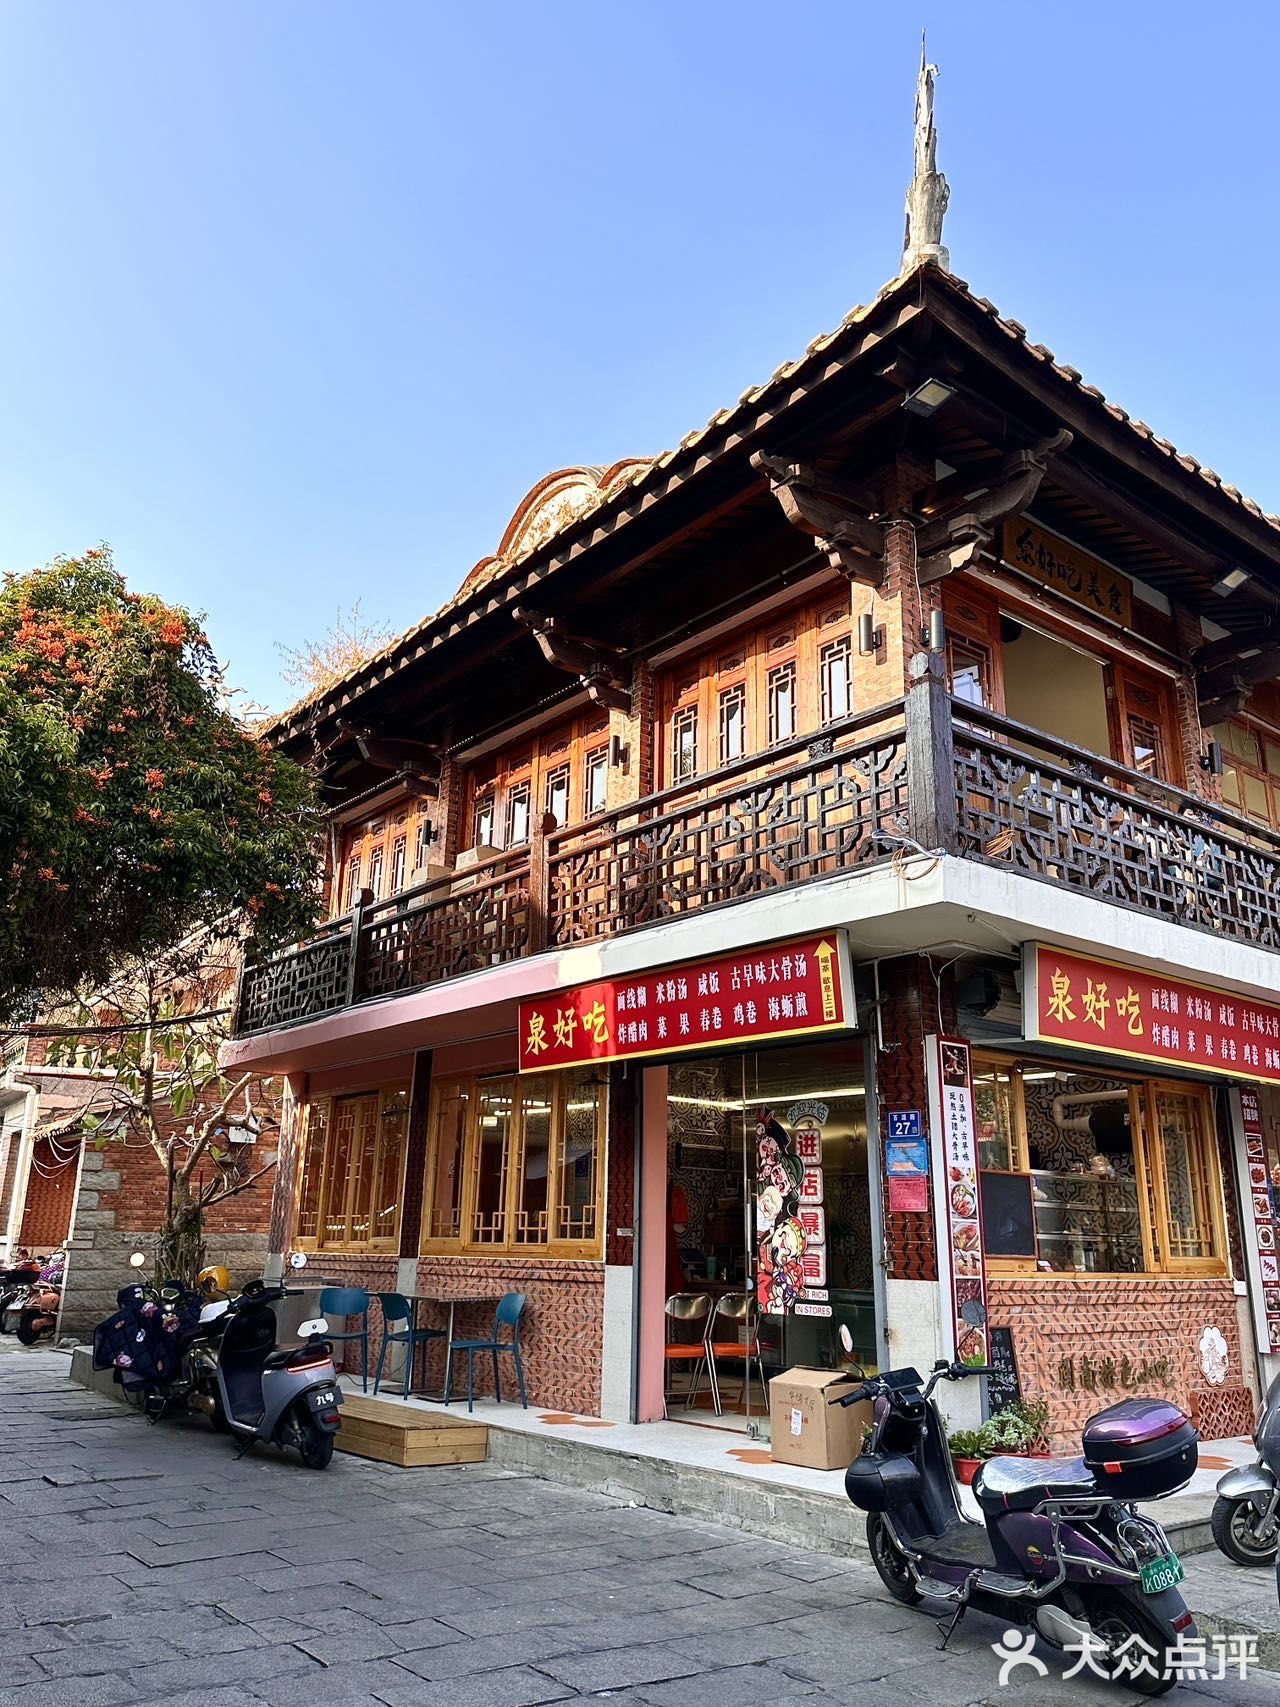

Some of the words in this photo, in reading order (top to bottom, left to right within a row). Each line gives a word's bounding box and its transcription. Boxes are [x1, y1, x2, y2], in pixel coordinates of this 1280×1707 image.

[616, 985, 647, 1012] 面线糊
[655, 977, 688, 1004] 米粉汤
[697, 970, 720, 996] 咸饭
[730, 953, 808, 991] 古早味大骨汤
[1045, 966, 1144, 1036] 泉好吃
[525, 999, 610, 1057] 泉好吃
[617, 1019, 648, 1045] 炸醋肉
[699, 1006, 723, 1032] 春卷
[733, 1000, 757, 1026] 鸡卷
[768, 992, 809, 1021] 海蛎煎
[1151, 988, 1179, 1014] 面线糊
[1186, 995, 1212, 1022] 米粉汤
[1219, 1003, 1235, 1027] 咸饭
[1151, 1022, 1179, 1050] 炸醋肉
[1220, 1036, 1237, 1061] 春卷
[1243, 1042, 1259, 1066] 鸡卷
[895, 1121, 911, 1135] 27
[796, 1305, 803, 1313] IN
[804, 1305, 831, 1316] STORES
[811, 1290, 827, 1300] RICH
[316, 1392, 334, 1406] 九号
